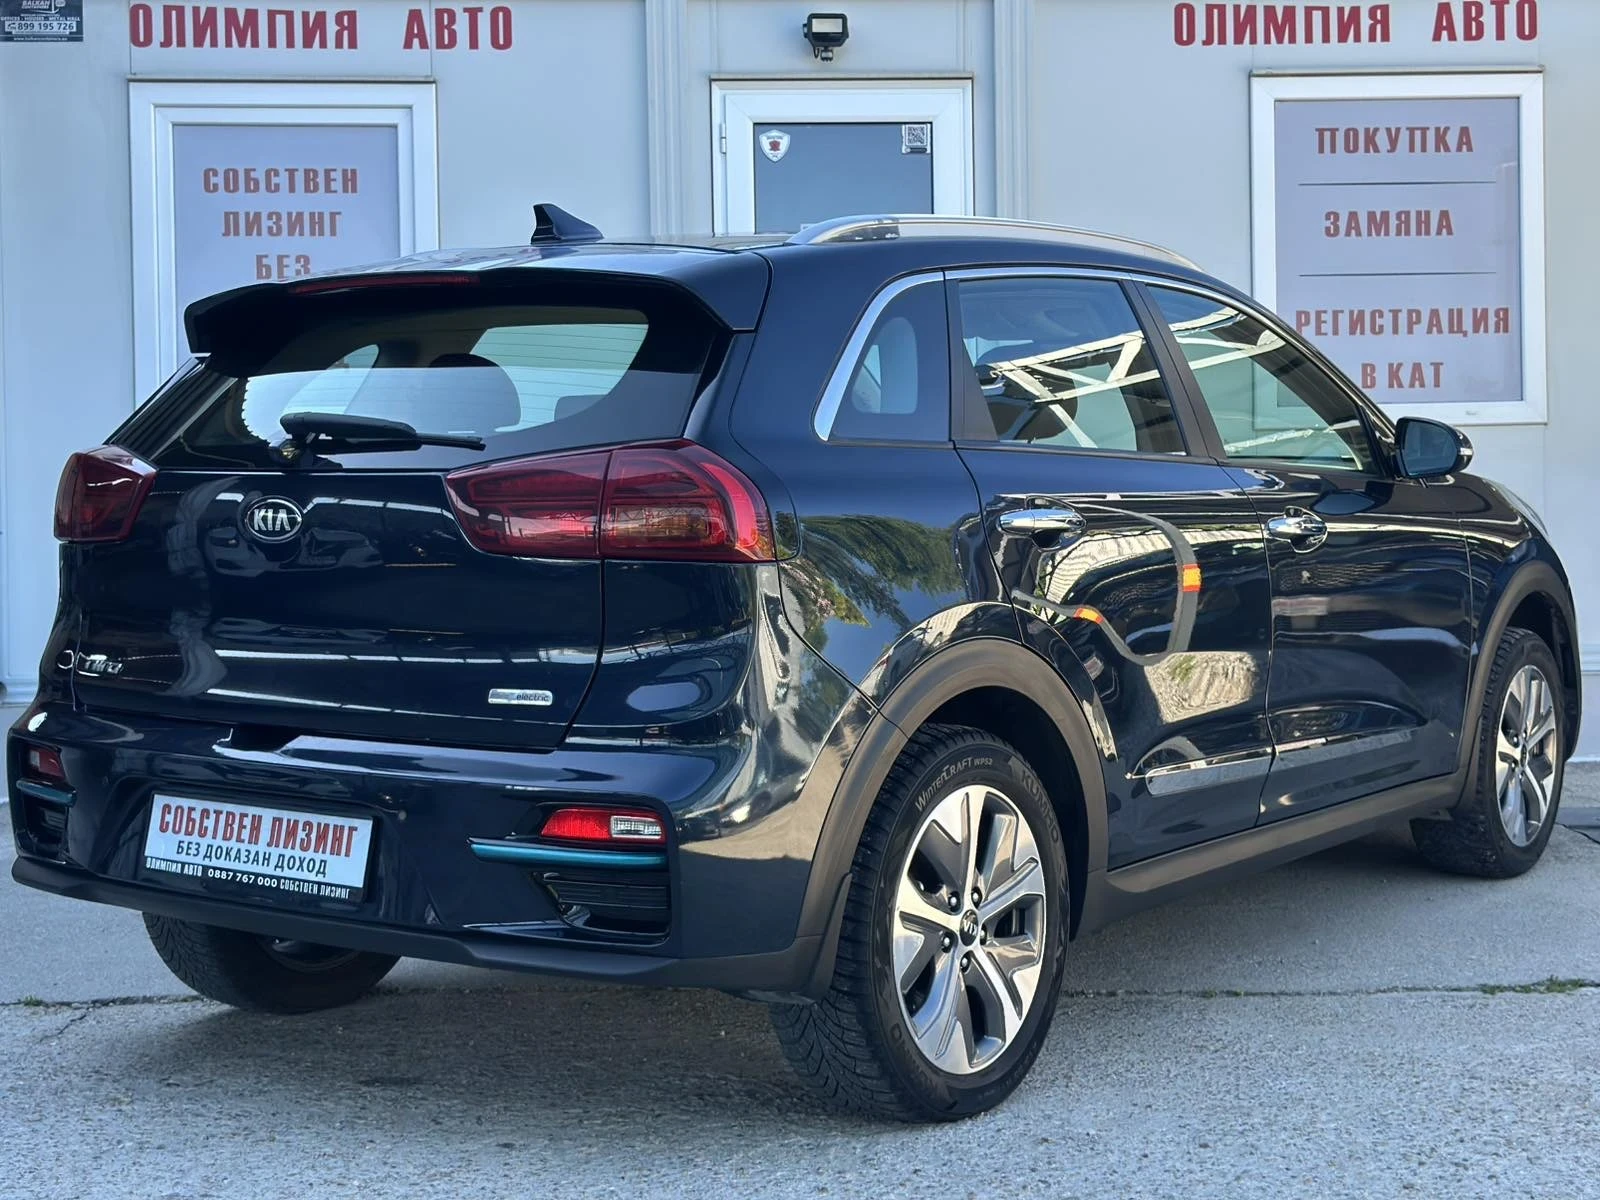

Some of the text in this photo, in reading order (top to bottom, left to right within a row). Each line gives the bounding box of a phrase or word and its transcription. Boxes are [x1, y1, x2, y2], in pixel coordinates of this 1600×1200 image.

[17, 22, 35, 31] 899
[38, 22, 54, 31] 195
[57, 22, 74, 31] 726
[129, 3, 513, 52] ОЛИМПИЯ АВТО
[1173, 0, 1538, 47] ОЛИМПИЯ АВТО
[1315, 126, 1474, 155] ПОКУПКА
[203, 167, 359, 195] СОБСТВЕН
[222, 211, 343, 237] ЛИЗИНГ
[1324, 210, 1454, 239] ЗАМЯНА
[255, 254, 312, 281] БЕЗ
[1295, 307, 1511, 338] РЕГИСТРАЦИЯ
[1361, 362, 1444, 389] В КАТ
[253, 508, 291, 531] KIA
[516, 692, 550, 703] electric
[1021, 770, 1060, 843] KUMHO
[158, 803, 358, 858] СОБСТВЕН ЛИЗИНГ
[176, 840, 328, 878] БЕЗ ДОКАЗАН ДОХОД
[183, 864, 203, 877] АВТО
[208, 869, 233, 881] 0887
[236, 873, 255, 884] 767
[257, 876, 278, 888] 000
[280, 878, 318, 895] СОБСТВЕН
[319, 883, 351, 900] ЛИЗИНГ
